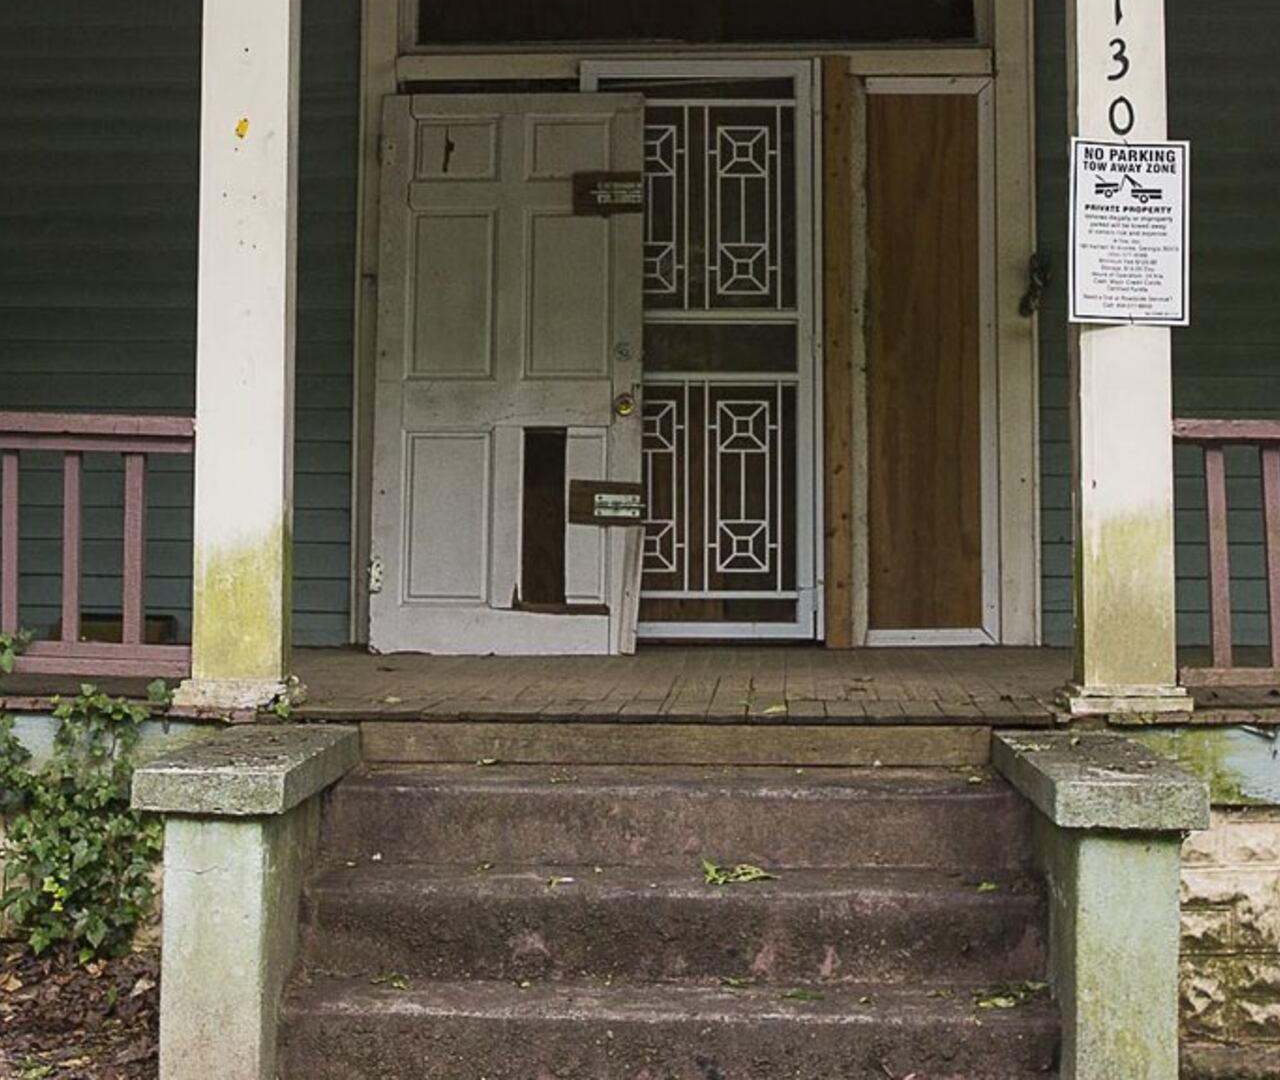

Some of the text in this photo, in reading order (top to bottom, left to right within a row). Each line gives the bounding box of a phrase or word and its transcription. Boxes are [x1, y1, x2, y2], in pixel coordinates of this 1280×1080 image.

[1084, 147, 1176, 163] NO PARKING
[1083, 161, 1176, 174] TOW AWAY ZONE
[1085, 204, 1173, 214] PRIVATE PROPERTY
